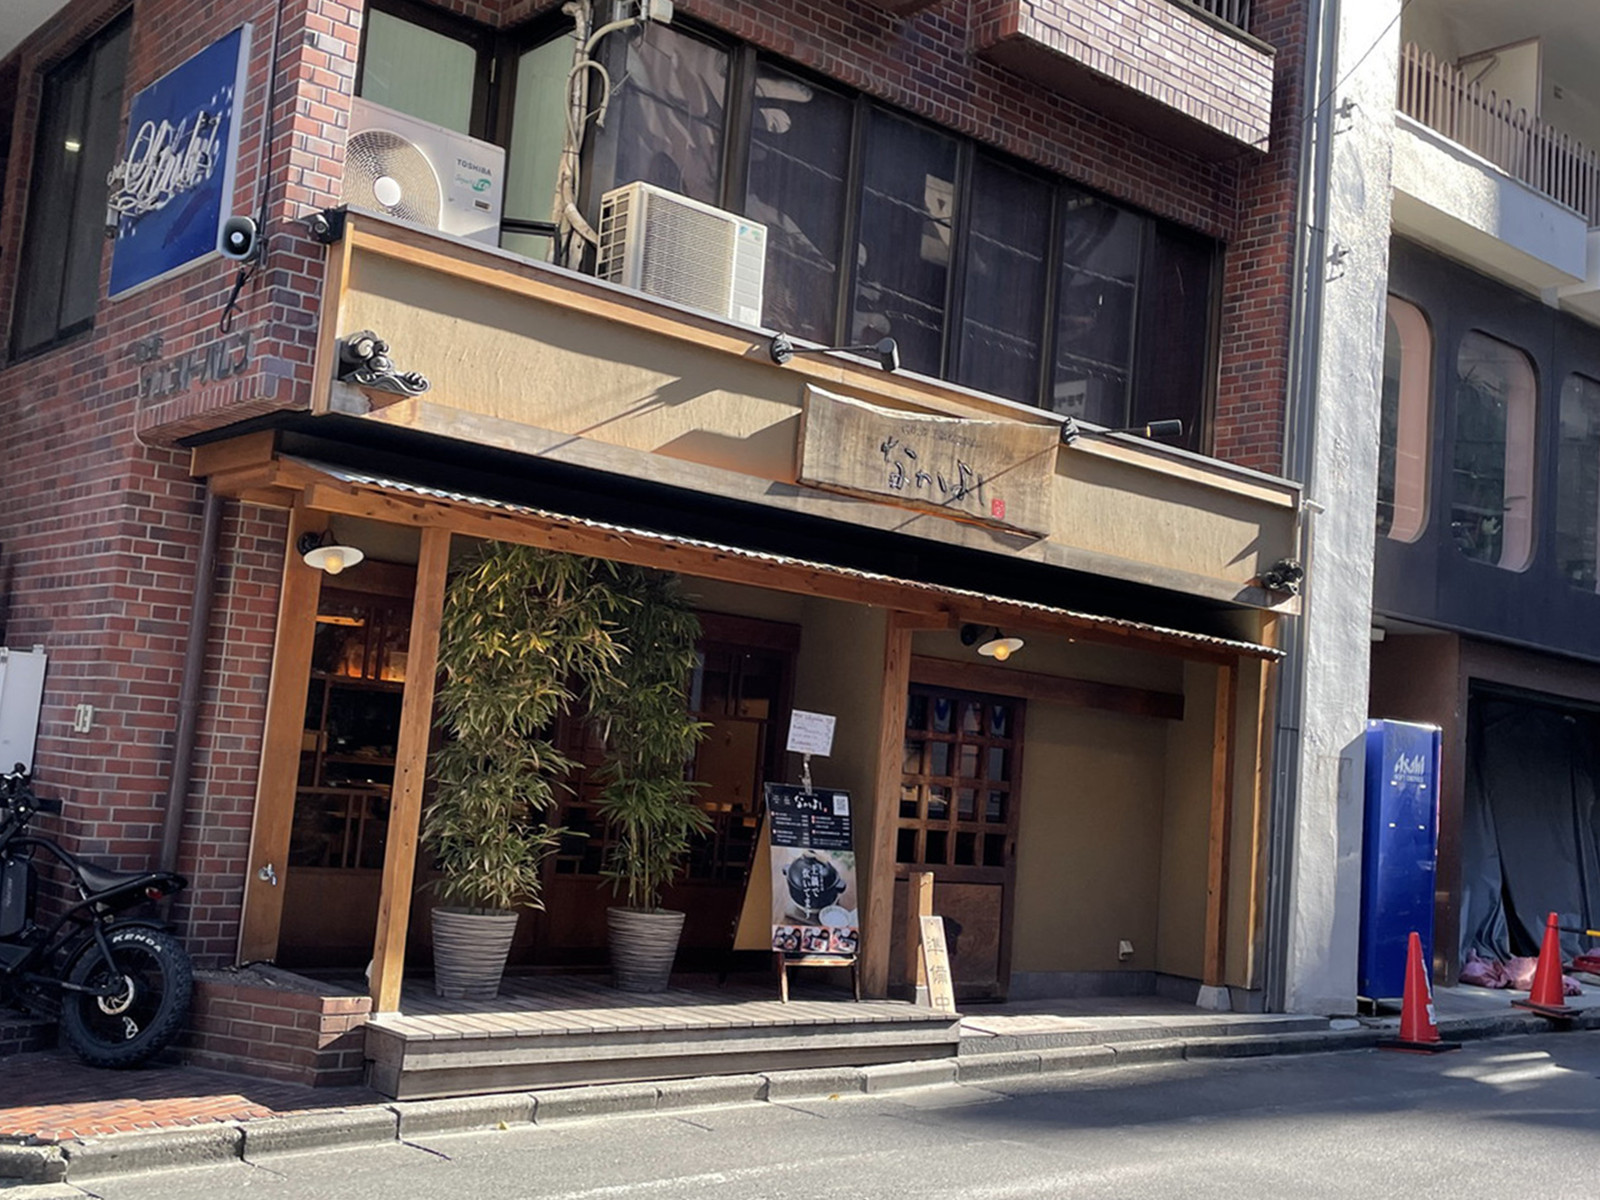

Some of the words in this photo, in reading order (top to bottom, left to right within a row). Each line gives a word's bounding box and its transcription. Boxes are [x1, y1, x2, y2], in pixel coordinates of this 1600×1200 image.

[457, 158, 492, 176] TOSHIBA
[1394, 752, 1425, 776] Asahi
[112, 933, 162, 952] KENDA
[926, 936, 951, 1012] 準備中
